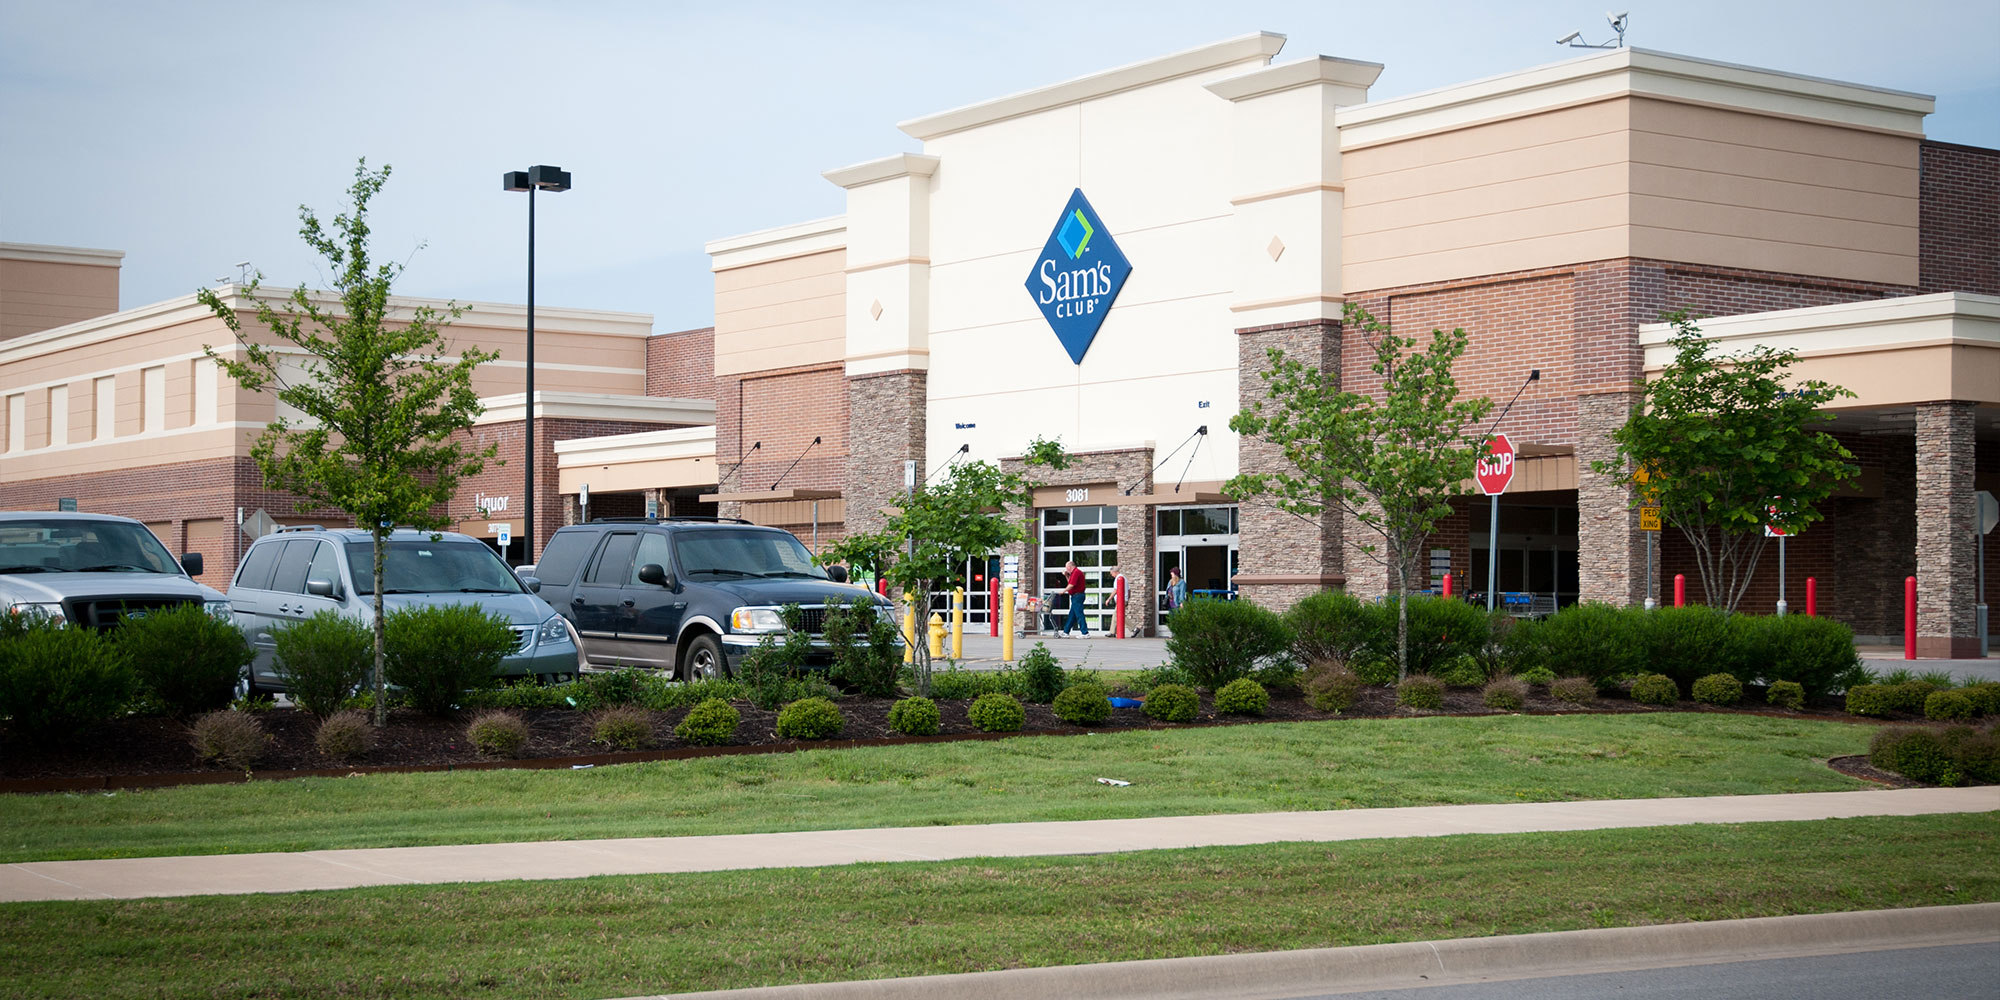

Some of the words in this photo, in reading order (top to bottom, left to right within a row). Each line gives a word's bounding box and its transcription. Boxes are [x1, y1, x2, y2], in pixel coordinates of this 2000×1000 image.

[1040, 259, 1111, 305] Sam's
[1198, 400, 1210, 409] Exit
[1065, 488, 1089, 503] 3081
[475, 492, 509, 517] Liquor
[1644, 508, 1657, 517] PED
[1643, 519, 1658, 528] XING
